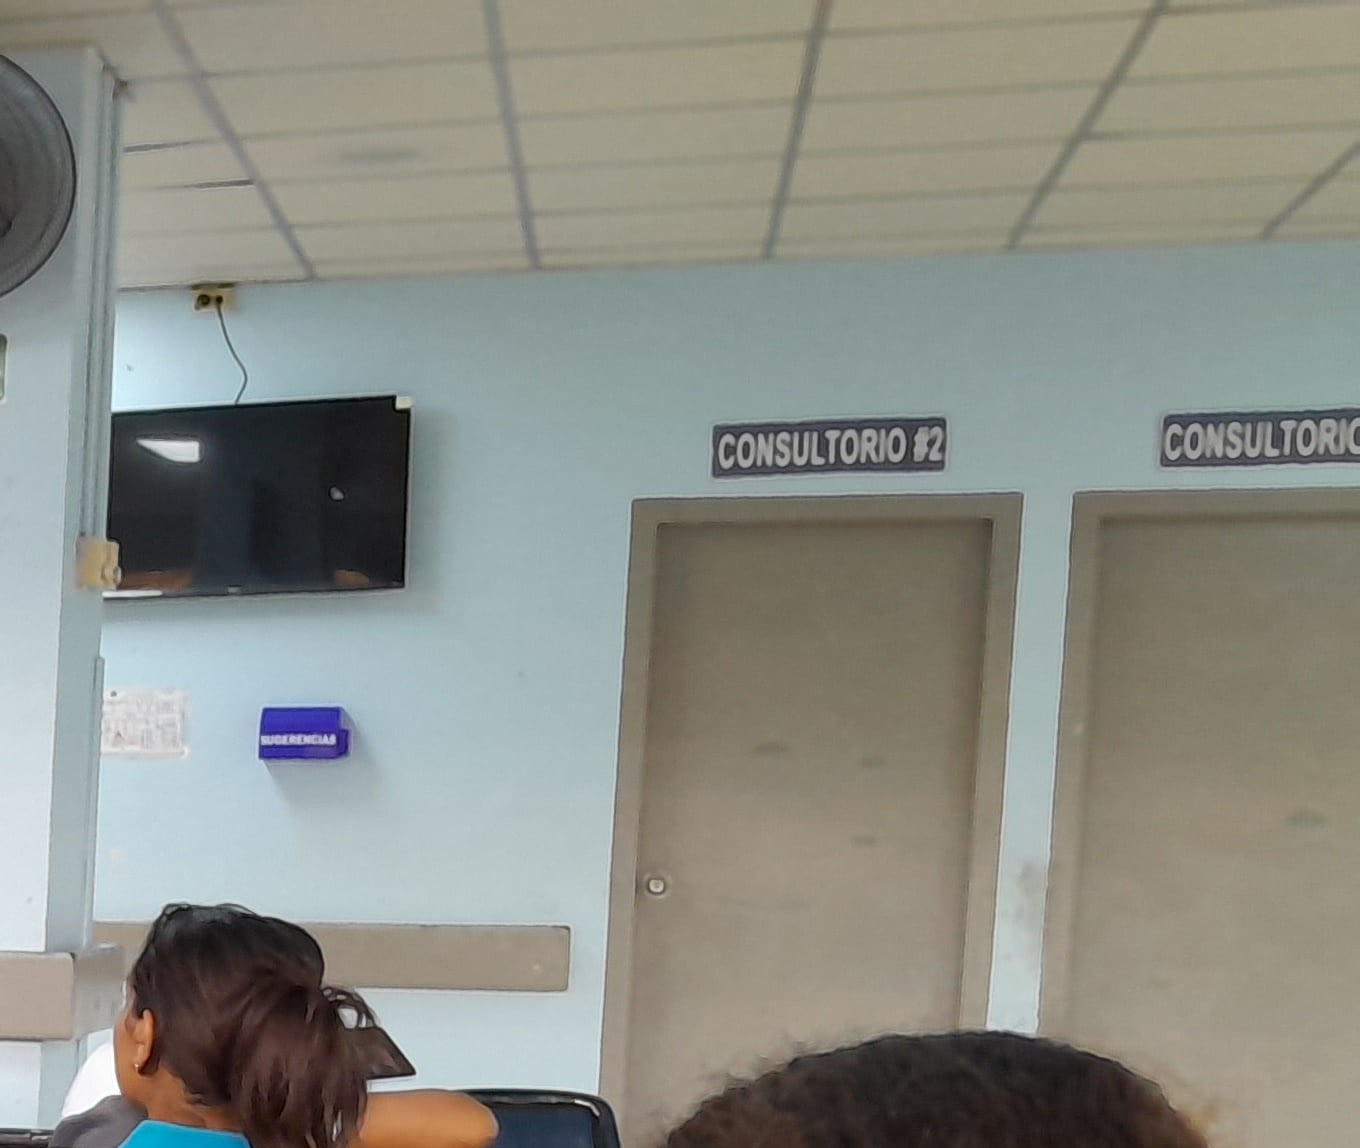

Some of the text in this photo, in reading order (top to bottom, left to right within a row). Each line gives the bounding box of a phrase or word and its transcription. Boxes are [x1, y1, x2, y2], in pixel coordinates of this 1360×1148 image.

[718, 425, 944, 470] CONSULTORIO #2
[260, 735, 337, 746] SUGERENCIAS
